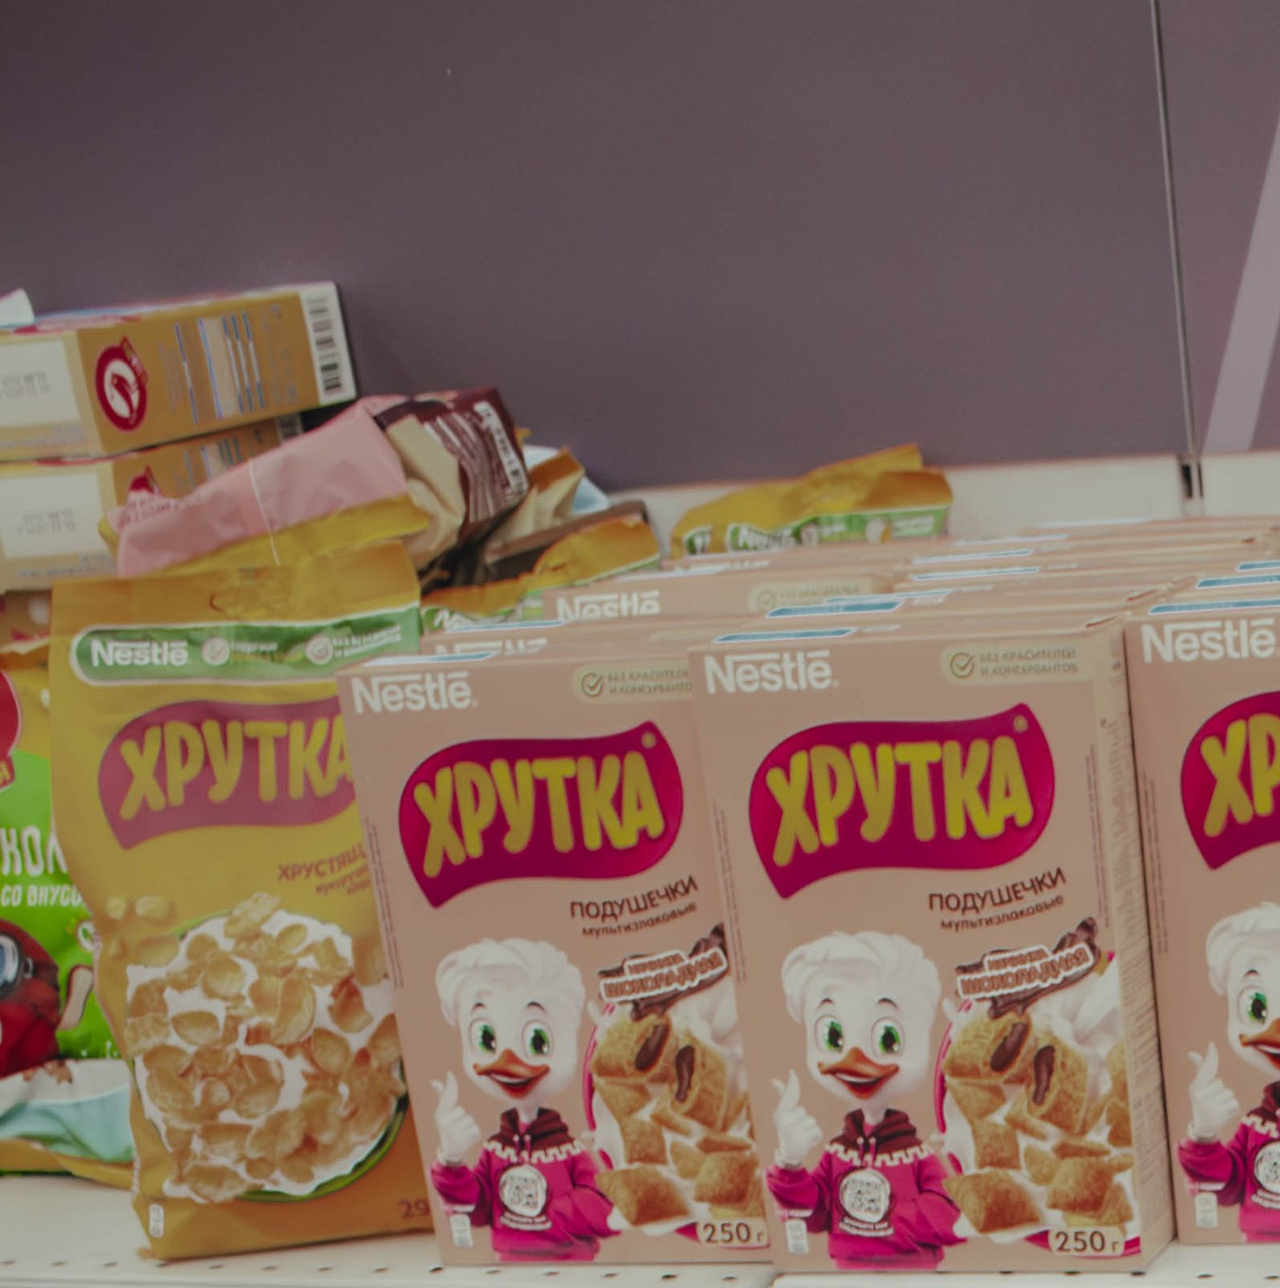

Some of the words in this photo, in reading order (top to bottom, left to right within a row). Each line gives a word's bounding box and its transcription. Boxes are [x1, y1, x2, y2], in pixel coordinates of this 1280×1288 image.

[986, 662, 1079, 676] КОНСЕРВАНТОВ
[1002, 648, 1077, 662] КРАСИТЕЛЕЙ
[119, 717, 354, 820] ХРУТКА
[413, 752, 665, 877] ХРУТКА
[766, 737, 1033, 867] ХРУТКА
[570, 875, 698, 922] ПОДУШЕЧКИ
[929, 868, 1067, 913] ПОДУШЕЧКИ
[582, 902, 697, 938] мультизлаковые
[940, 895, 1064, 932] мультизлаковые
[602, 953, 724, 998] ШОКОЛАДНАЯ
[960, 948, 1090, 994] ШОКОЛАДНАЯ
[704, 1223, 749, 1244] 250
[1054, 1230, 1106, 1253] 250
